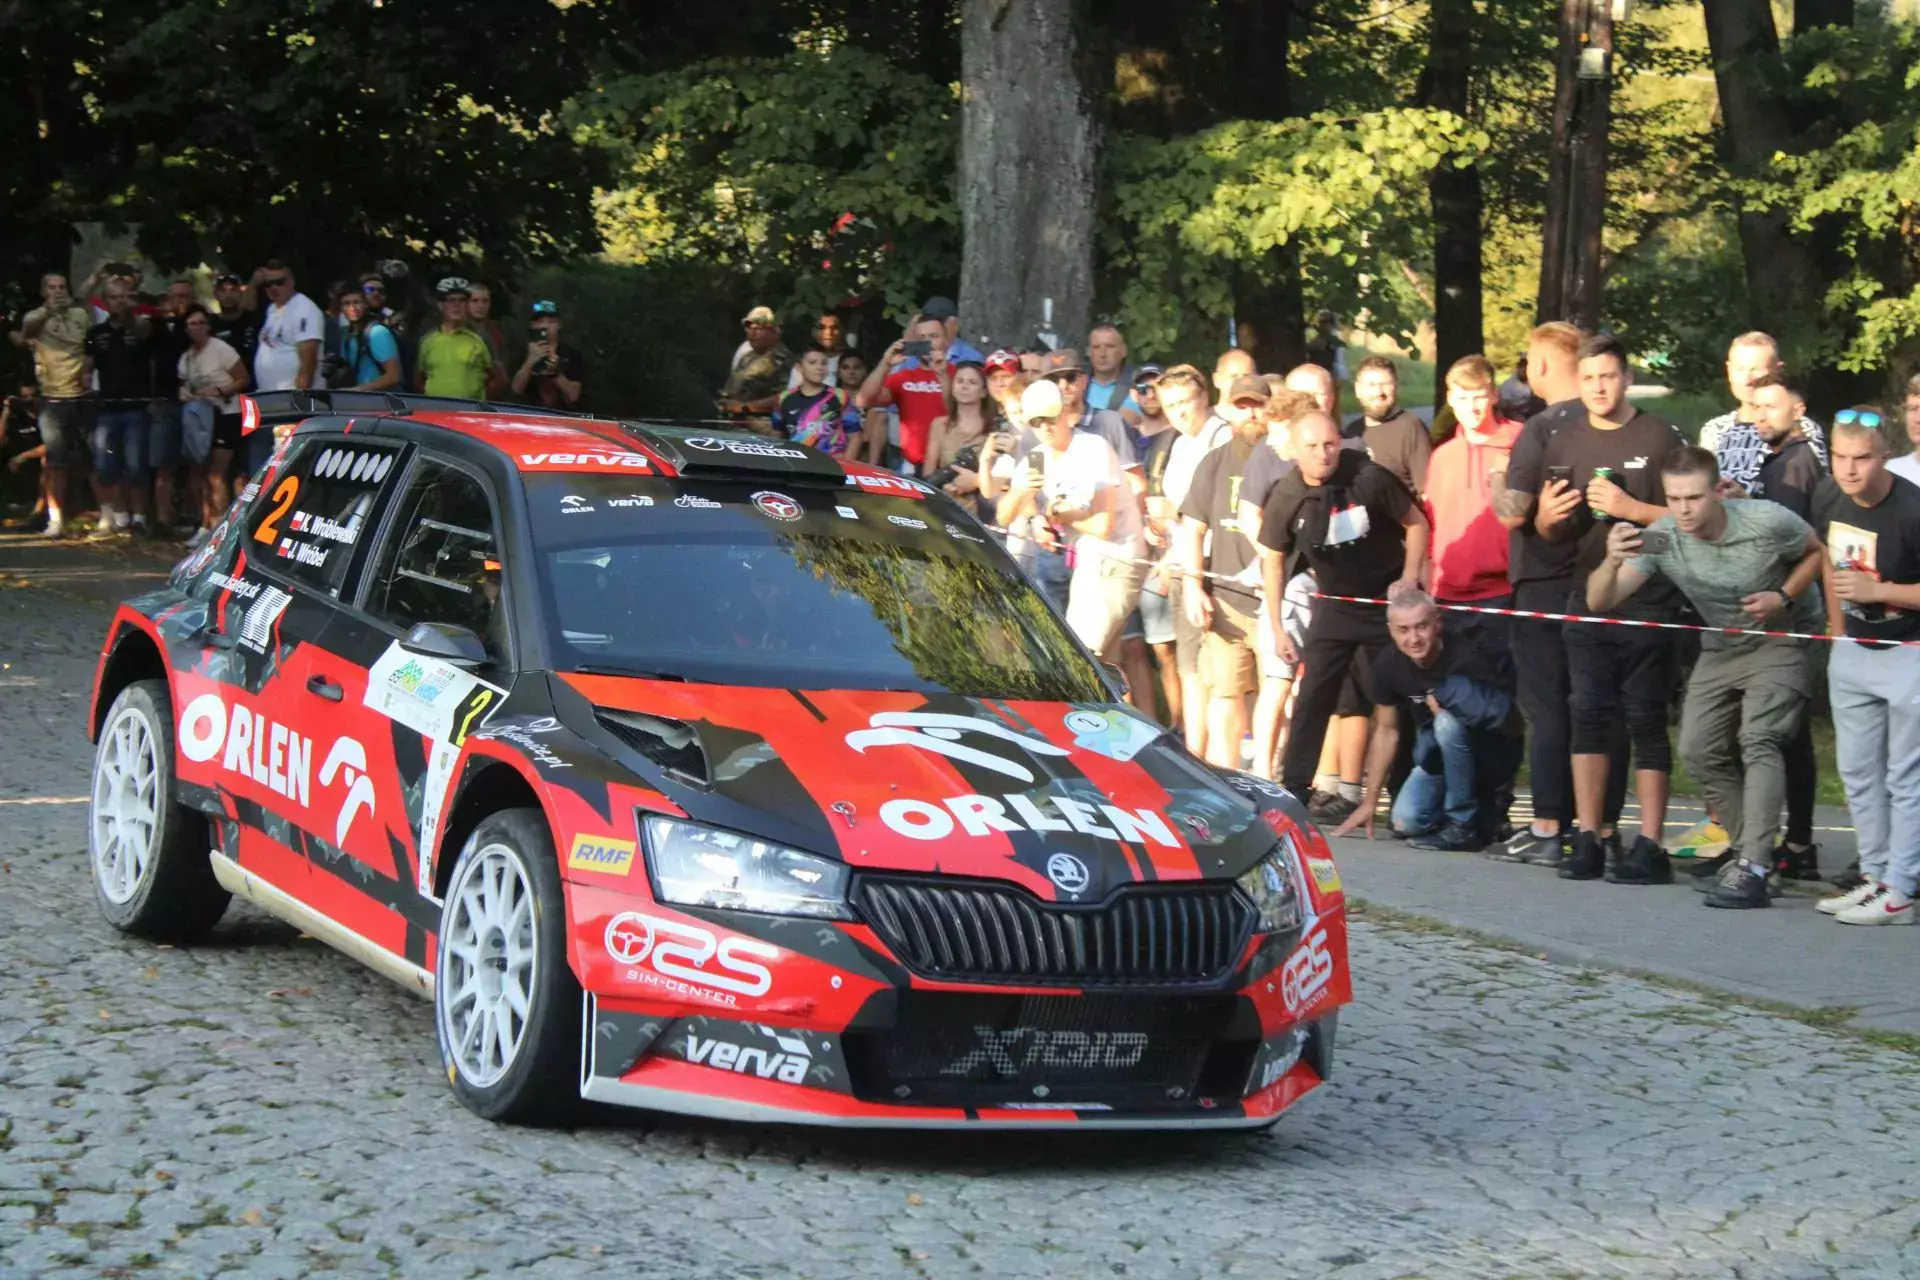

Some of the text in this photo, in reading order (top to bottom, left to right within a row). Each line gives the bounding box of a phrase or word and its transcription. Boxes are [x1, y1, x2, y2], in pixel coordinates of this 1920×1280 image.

[520, 453, 648, 468] verva
[254, 475, 299, 545] 2
[561, 506, 595, 514] ORLEN
[608, 496, 653, 507] verva
[299, 513, 361, 545] K. Wróblewski
[286, 543, 329, 568] J. Wróbel
[455, 689, 493, 748] 2
[1077, 717, 1100, 729] 2
[179, 694, 313, 808] ORLEN
[880, 794, 1182, 850] ORLEN
[575, 843, 632, 865] RMF
[627, 969, 737, 1006] SIM-CENTER
[686, 1034, 812, 1085] verva
